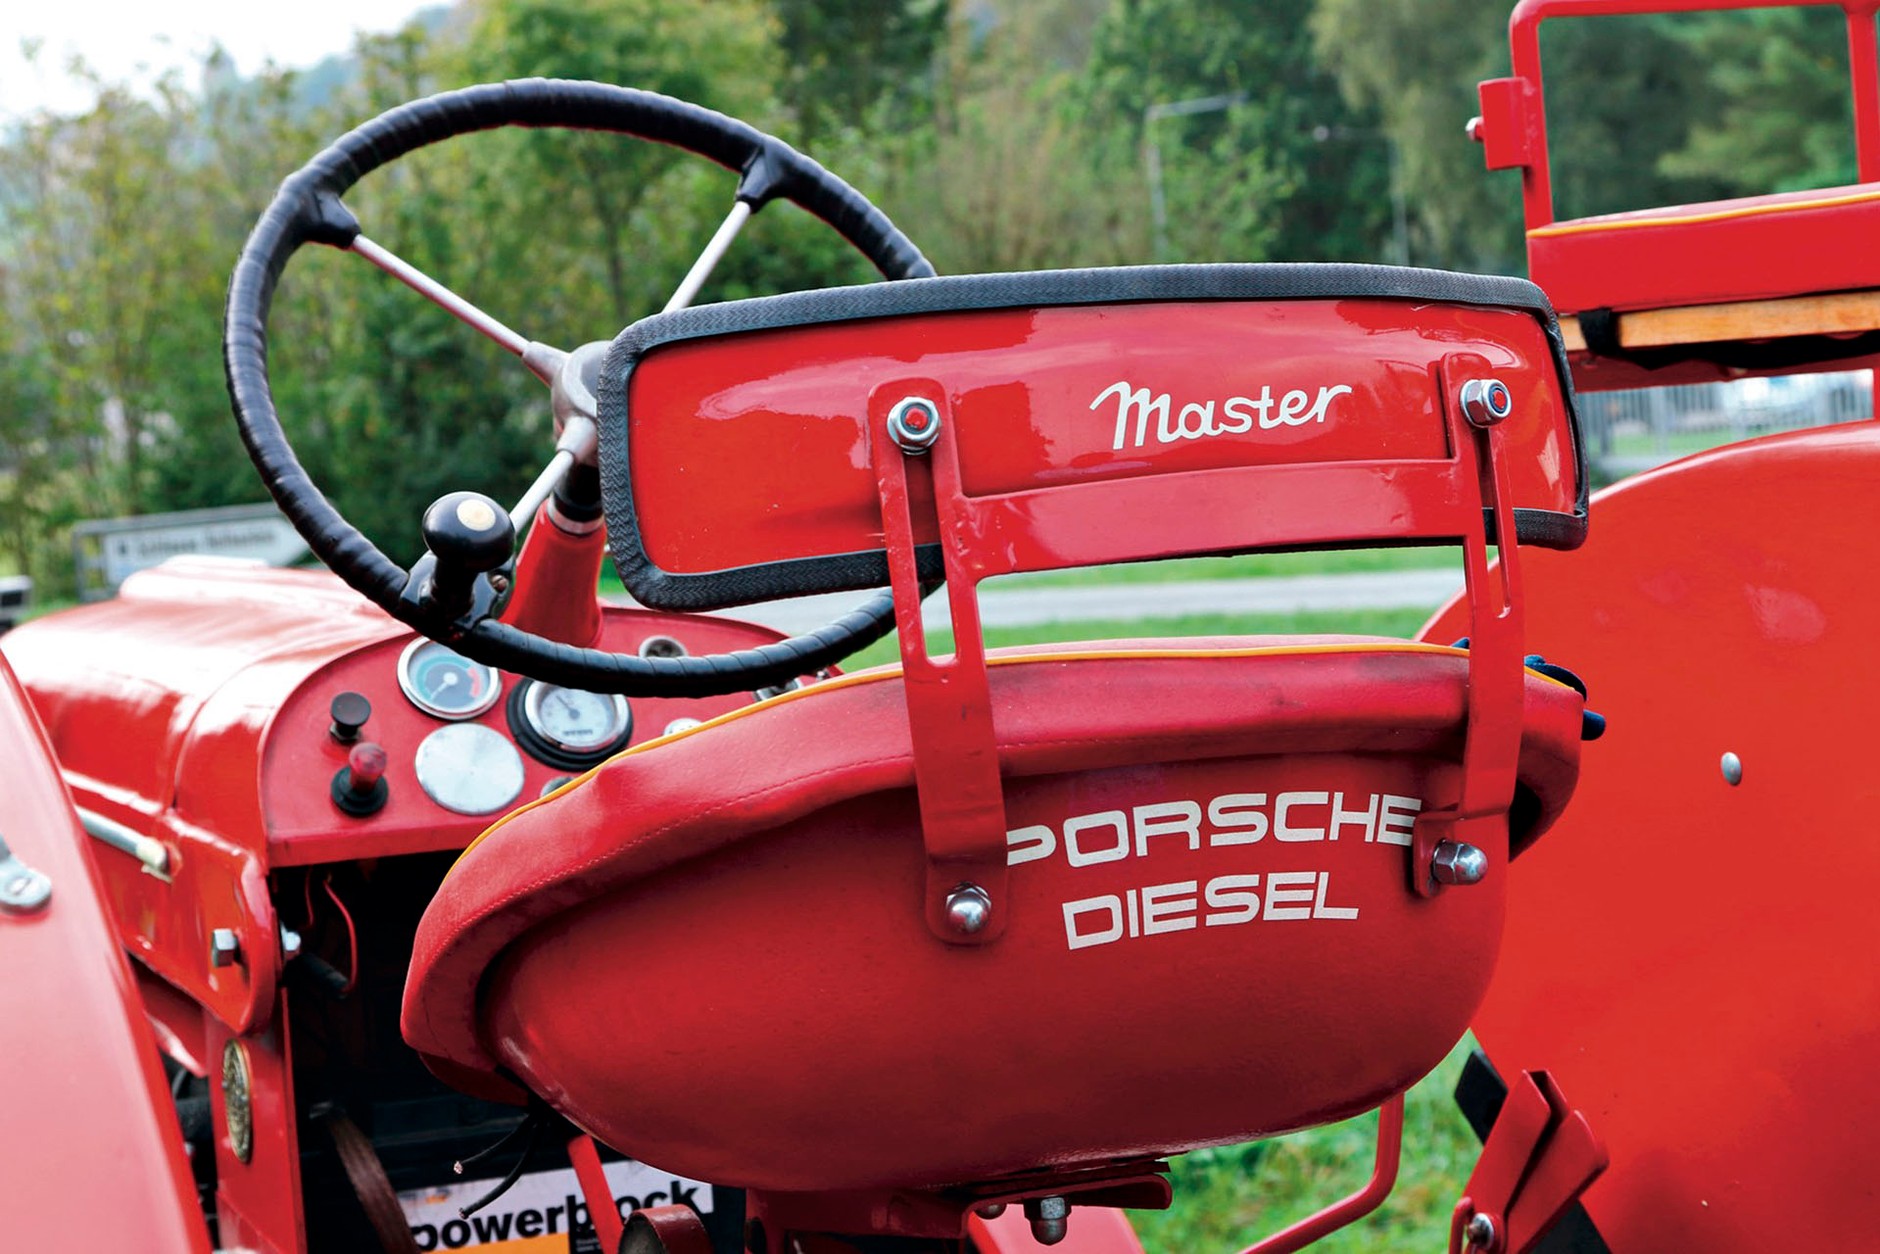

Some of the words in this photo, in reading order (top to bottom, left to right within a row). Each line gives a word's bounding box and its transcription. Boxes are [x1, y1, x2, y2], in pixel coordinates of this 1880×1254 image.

[1089, 381, 1352, 450] Master
[1006, 791, 1422, 867] PORSCHE
[1062, 871, 1359, 950] DIESEL
[410, 1180, 706, 1252] powerbock
